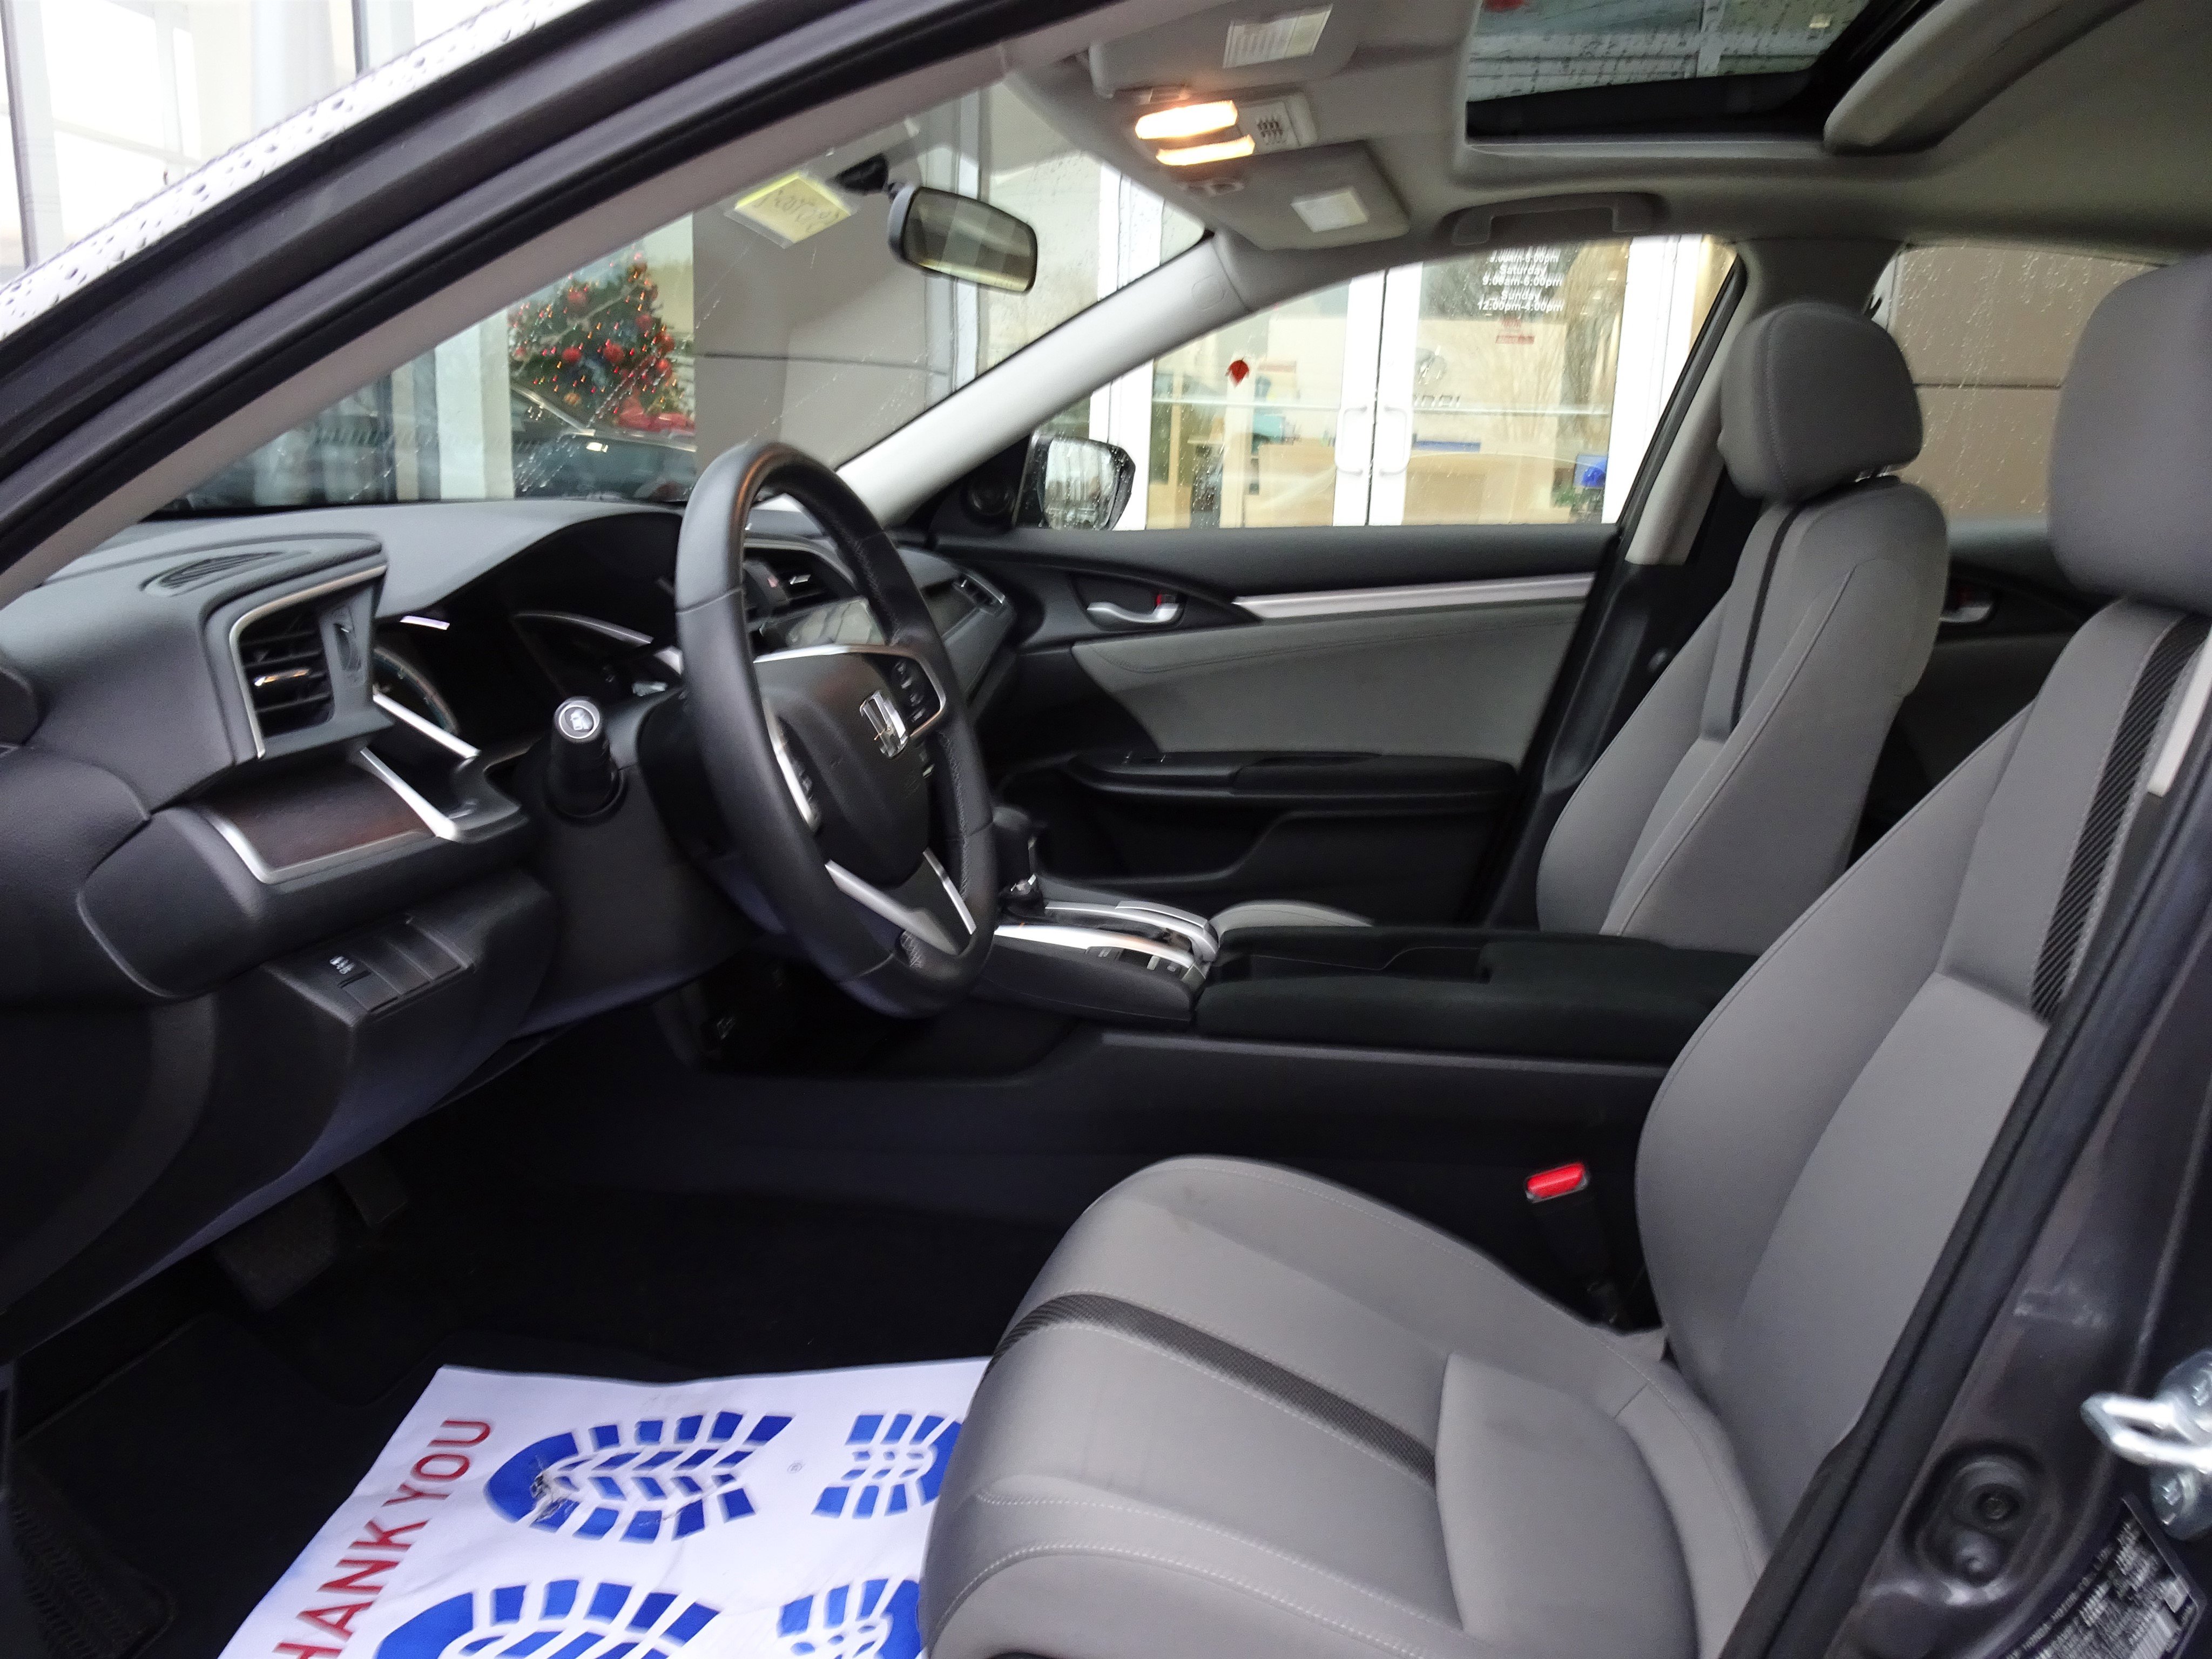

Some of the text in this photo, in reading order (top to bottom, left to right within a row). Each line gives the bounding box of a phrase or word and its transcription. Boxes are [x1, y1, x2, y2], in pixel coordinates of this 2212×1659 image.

[1499, 264, 1548, 276] Saturday
[1501, 289, 1542, 302] Sunday
[381, 1418, 492, 1508] YOU
